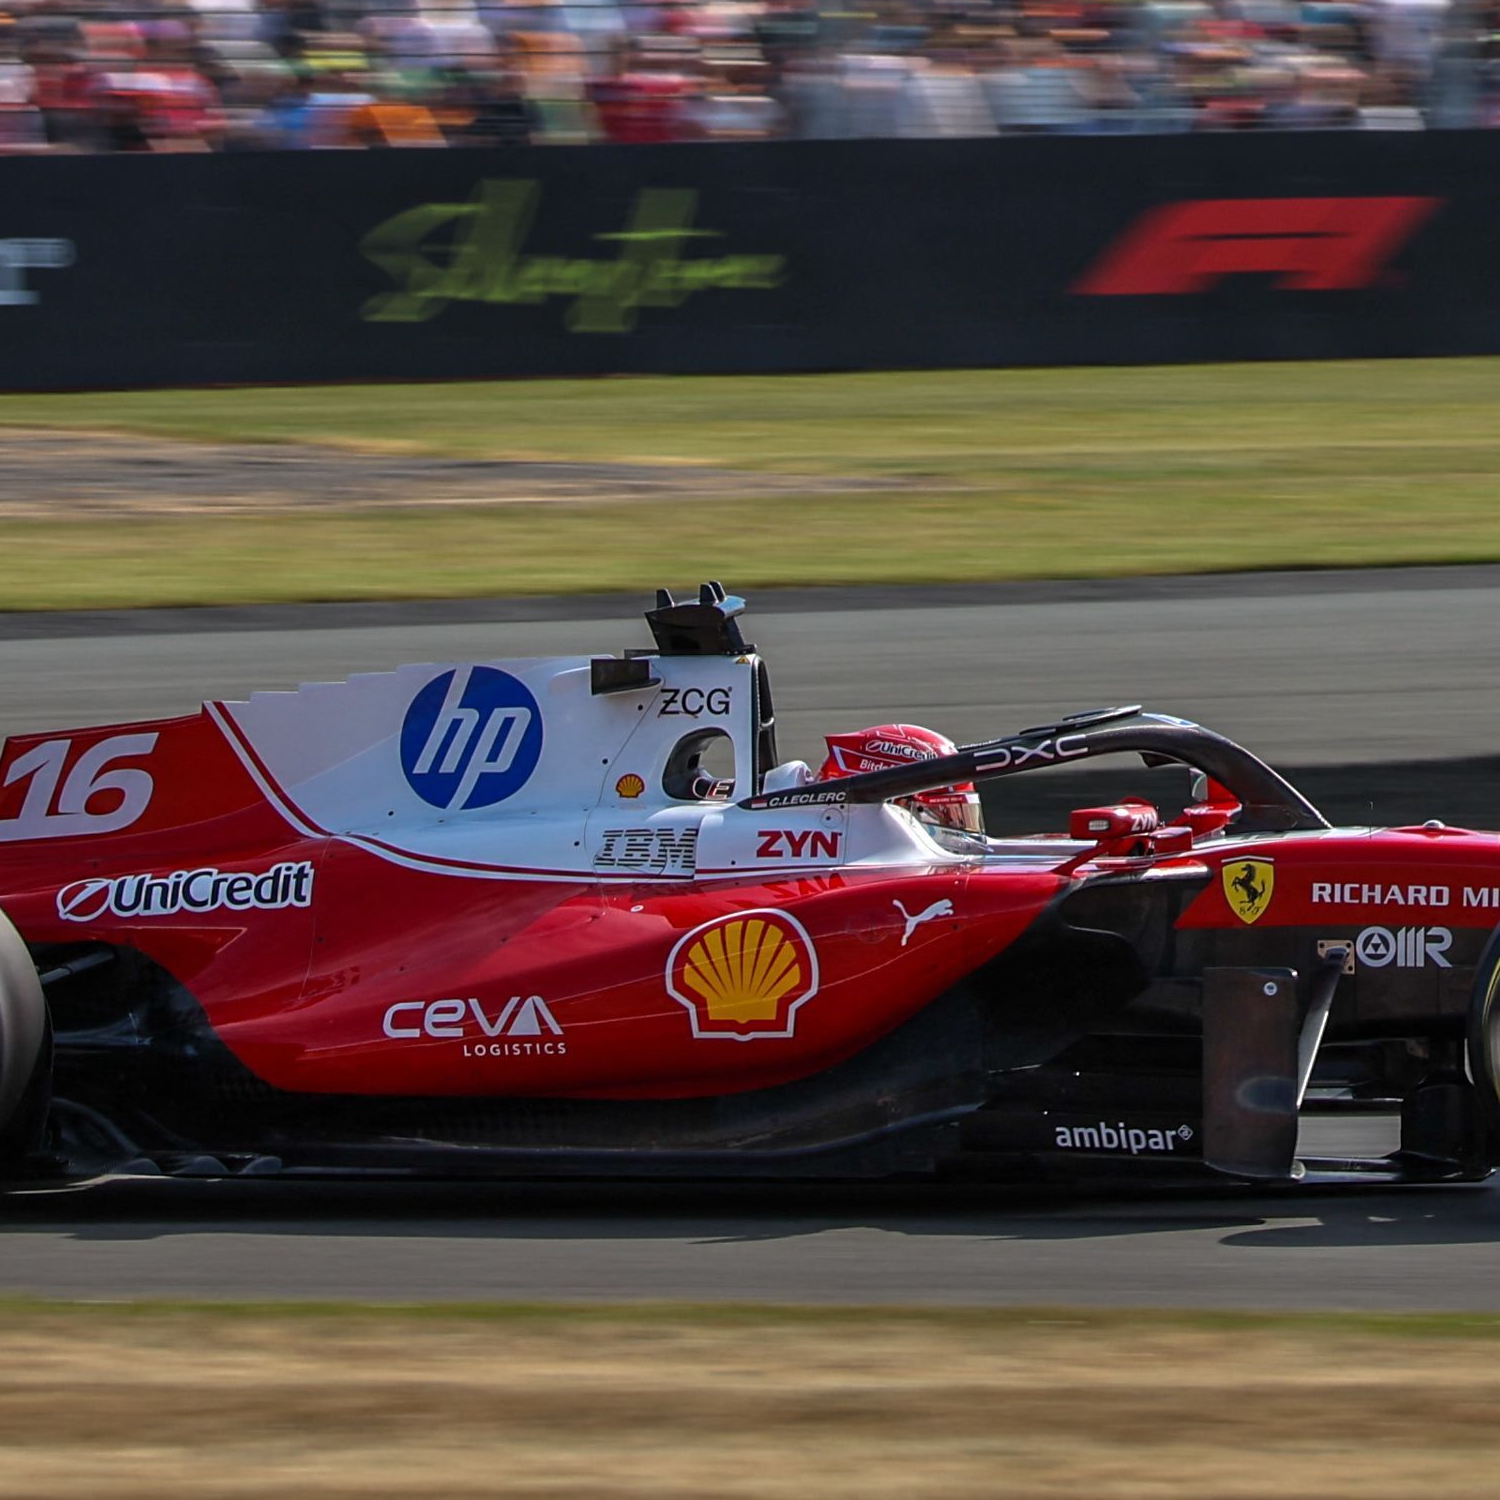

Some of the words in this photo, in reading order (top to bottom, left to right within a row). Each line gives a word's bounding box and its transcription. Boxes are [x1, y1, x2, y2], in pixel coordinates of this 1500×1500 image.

[411, 664, 532, 811] hp
[768, 791, 846, 808] C.LECLERC
[594, 827, 699, 869] IBM
[755, 830, 840, 858] ZYN
[111, 862, 314, 916] UniCredit
[1311, 882, 1450, 907] RICHARD
[463, 1042, 567, 1057] LOGISTICS
[1055, 1121, 1177, 1155] ambipar
